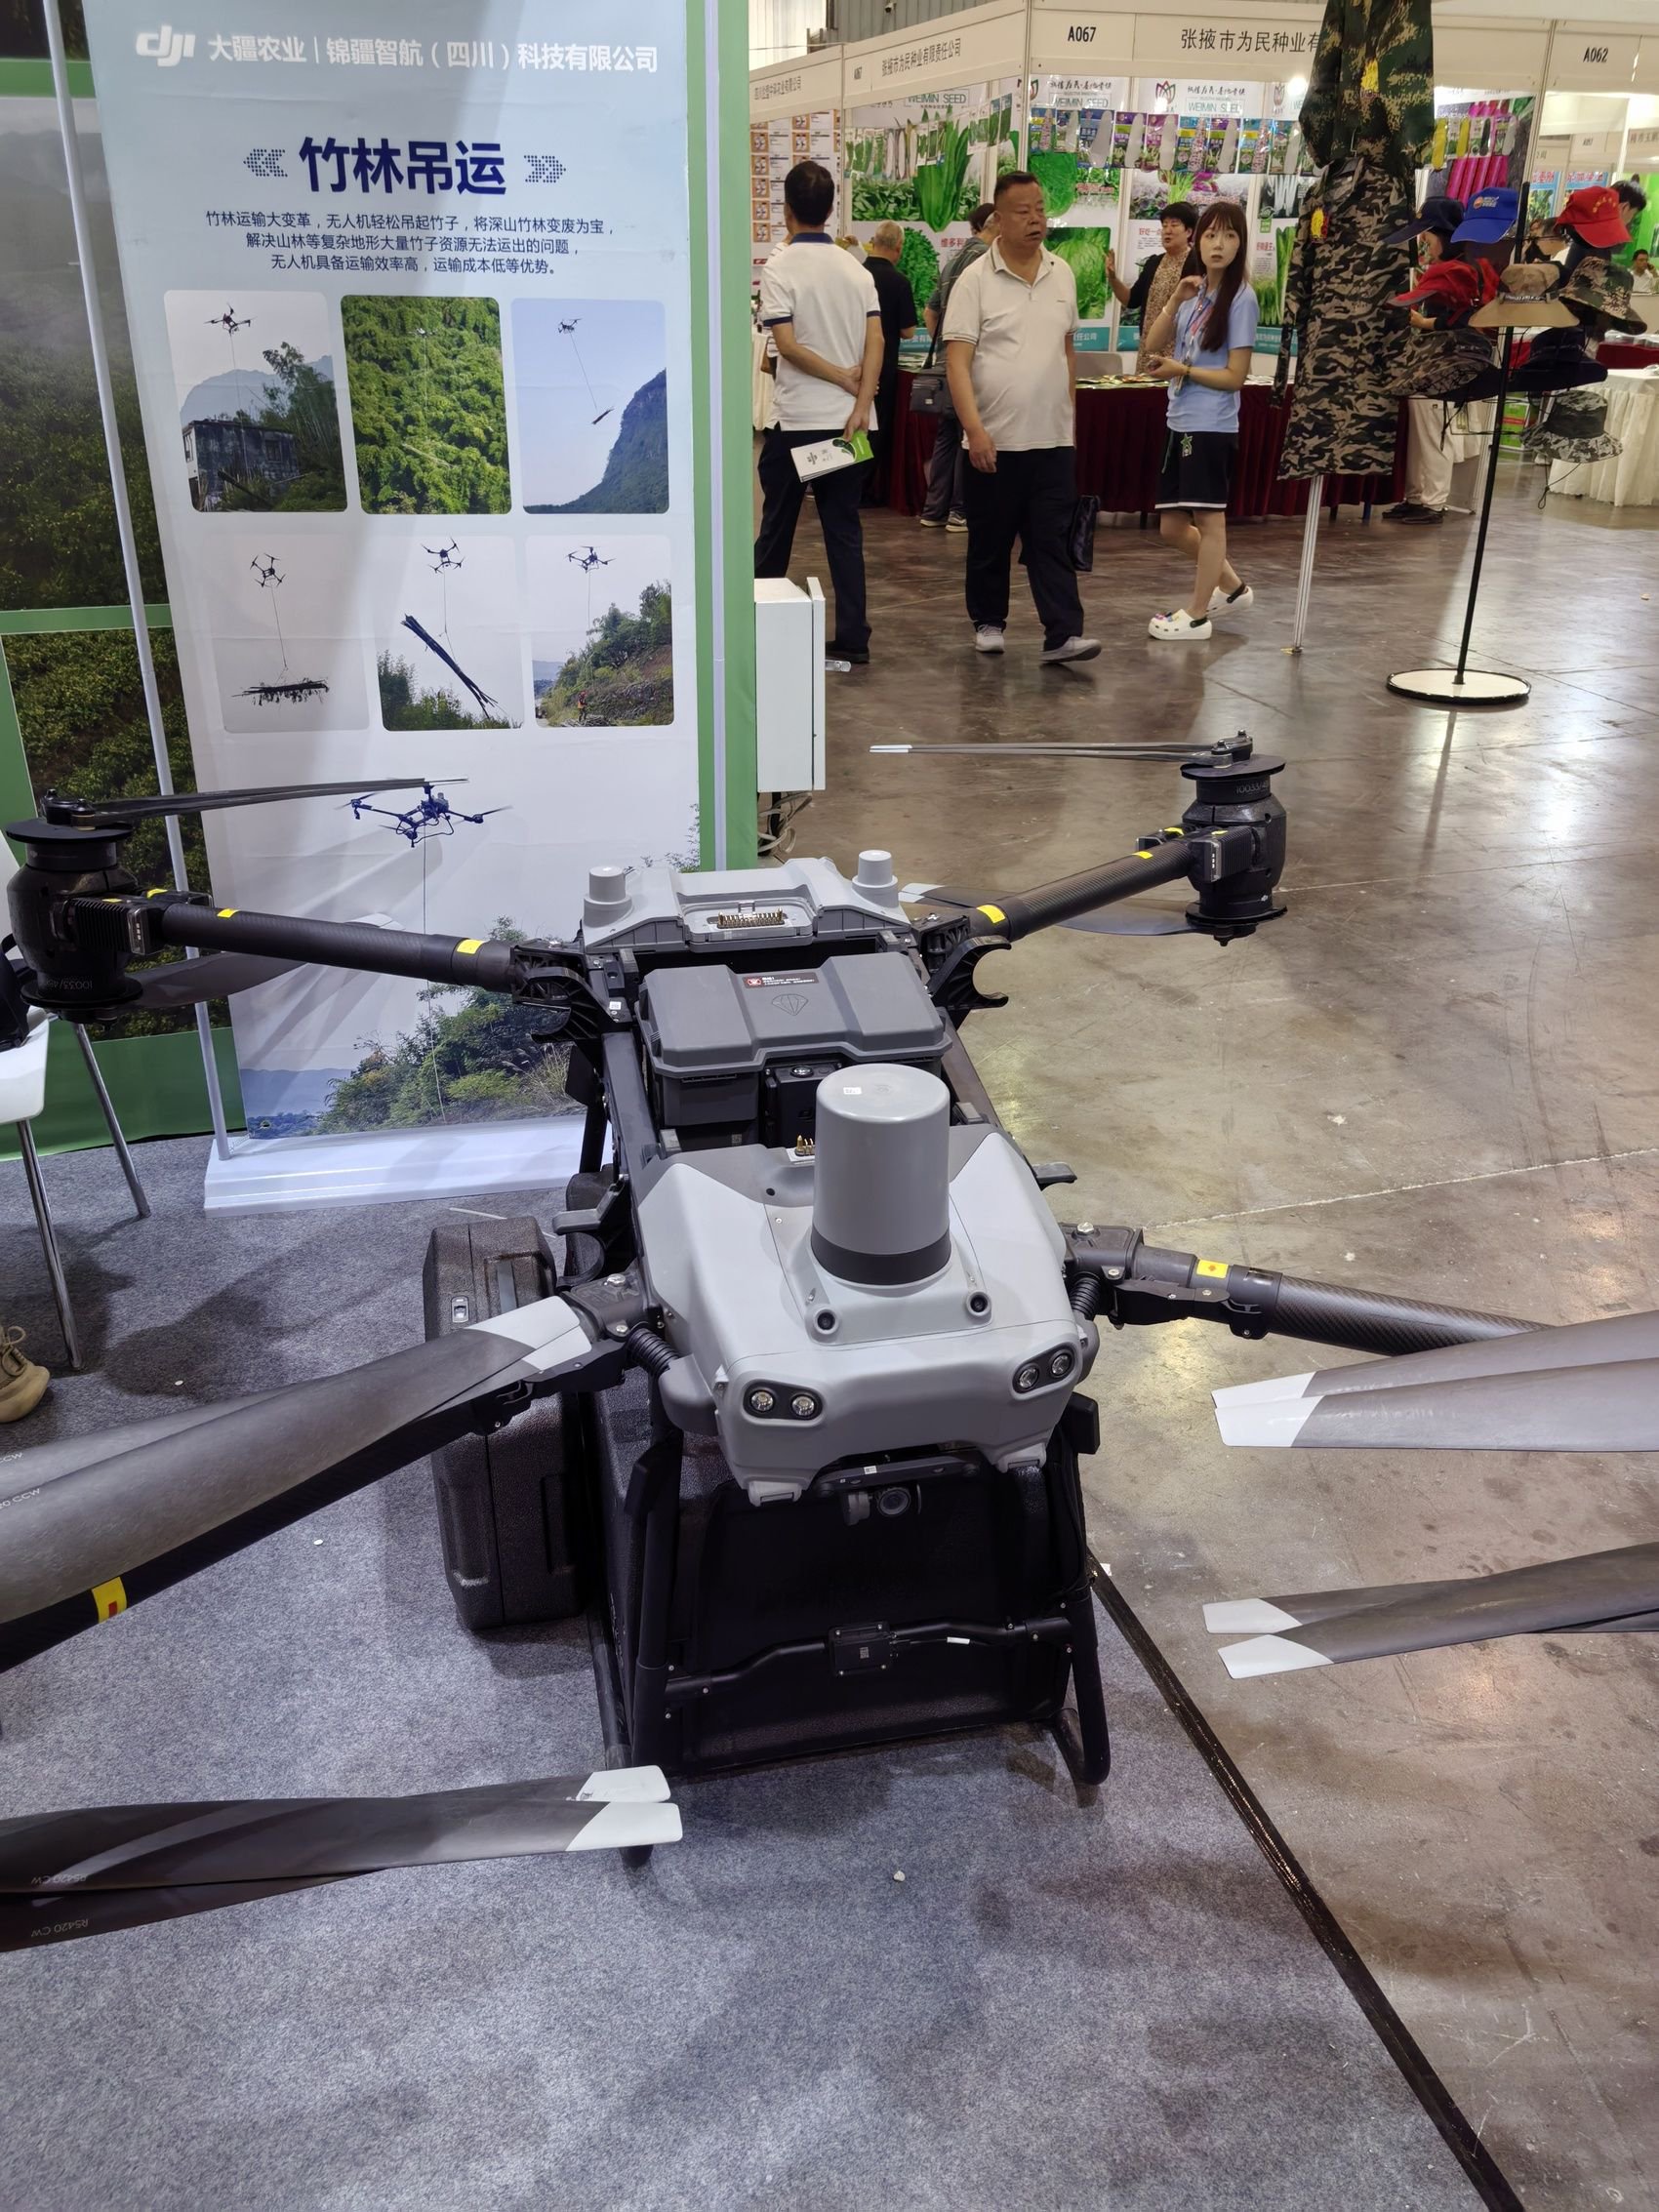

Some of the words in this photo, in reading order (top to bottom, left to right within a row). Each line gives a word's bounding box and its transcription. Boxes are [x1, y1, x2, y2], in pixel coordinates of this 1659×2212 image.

[1067, 25, 1096, 43] A067
[208, 34, 307, 63] 大疆农业
[1583, 47, 1609, 63] A062
[943, 94, 967, 104] SEED
[1188, 101, 1218, 112] WEIMIN
[299, 136, 506, 195] 竹林吊运
[13, 1488, 40, 1503] CCW
[30, 1874, 52, 1885] CW
[30, 1926, 52, 1939] CW
